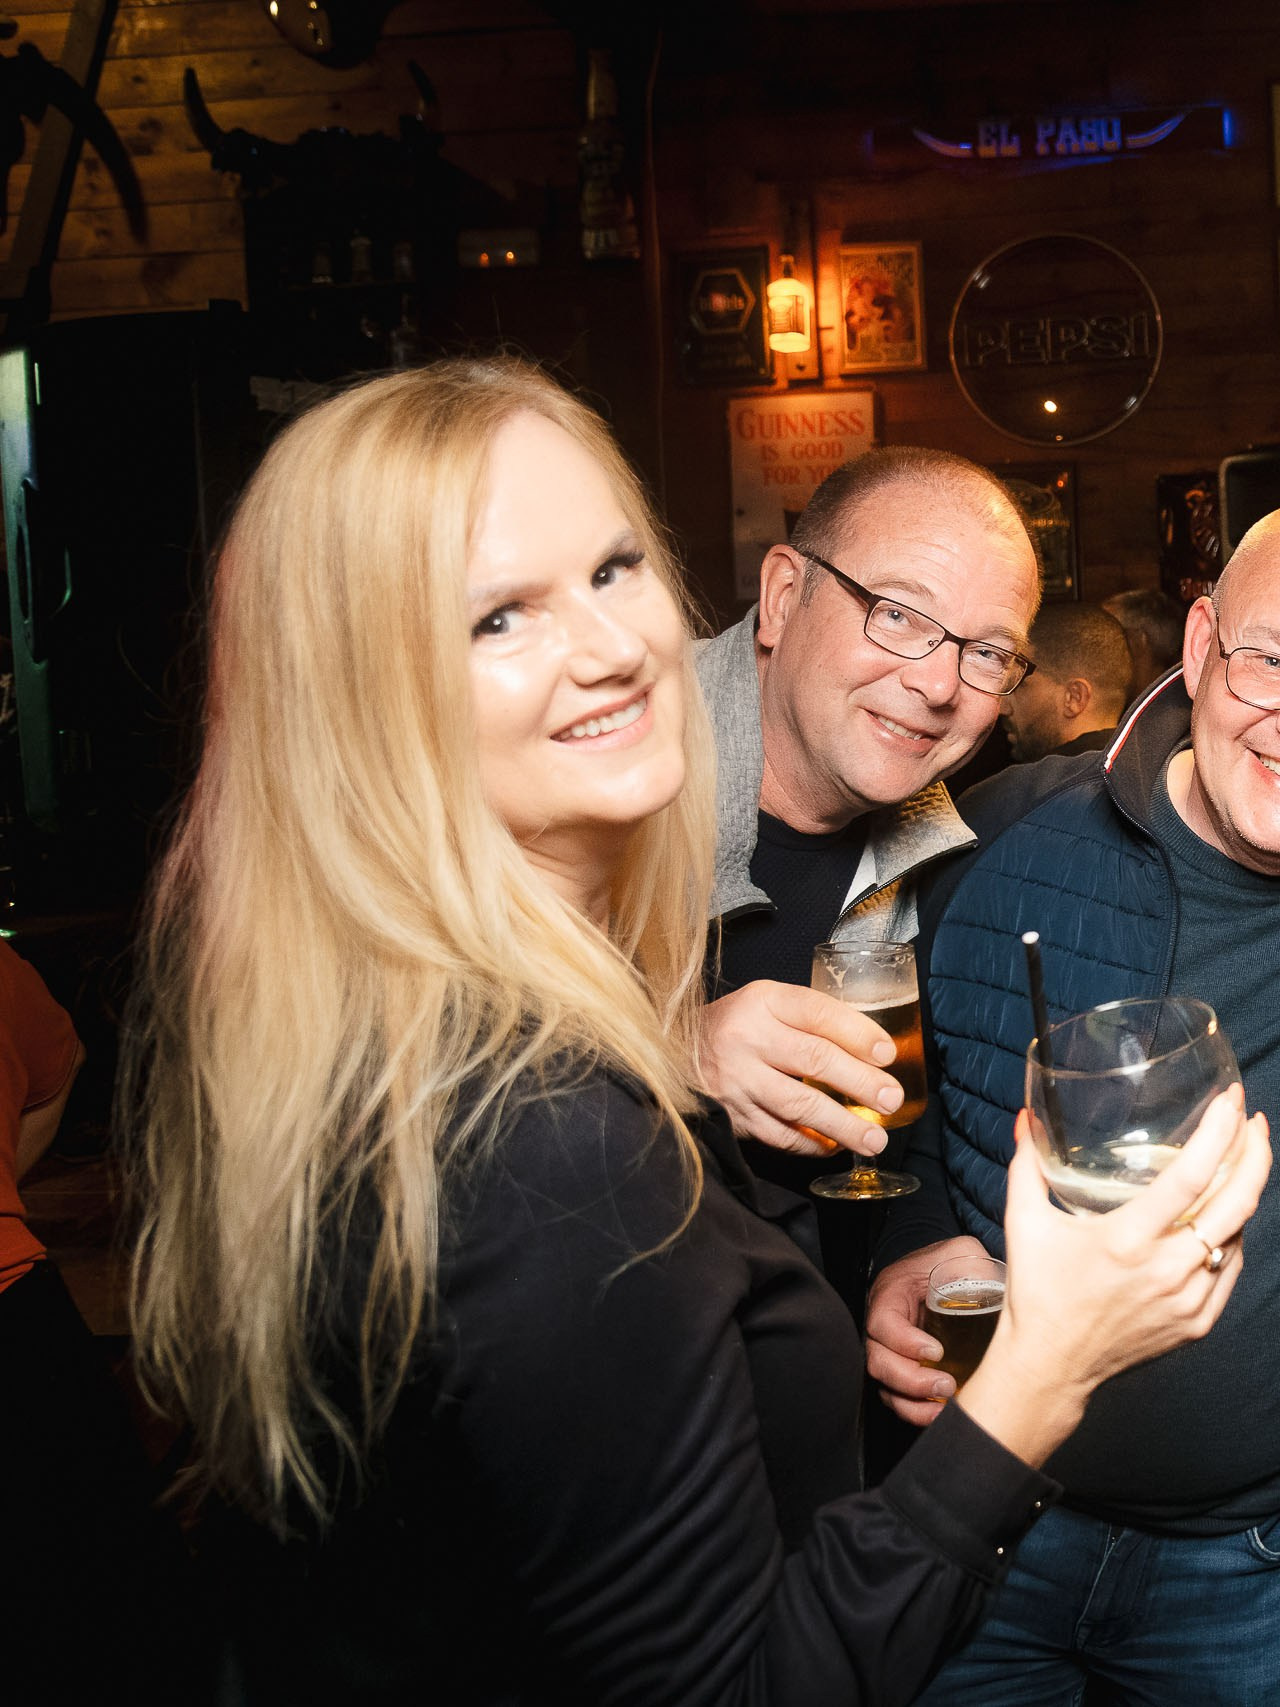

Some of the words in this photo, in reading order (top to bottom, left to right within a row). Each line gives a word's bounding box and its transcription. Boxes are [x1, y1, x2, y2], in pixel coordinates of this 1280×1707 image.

[978, 119, 1020, 157] EL
[963, 310, 1153, 367] PEPSI
[736, 408, 865, 441] GUINNESS
[761, 444, 779, 462] IS
[791, 441, 843, 462] GOOD
[761, 465, 801, 487] FOR
[806, 464, 837, 485] YO
